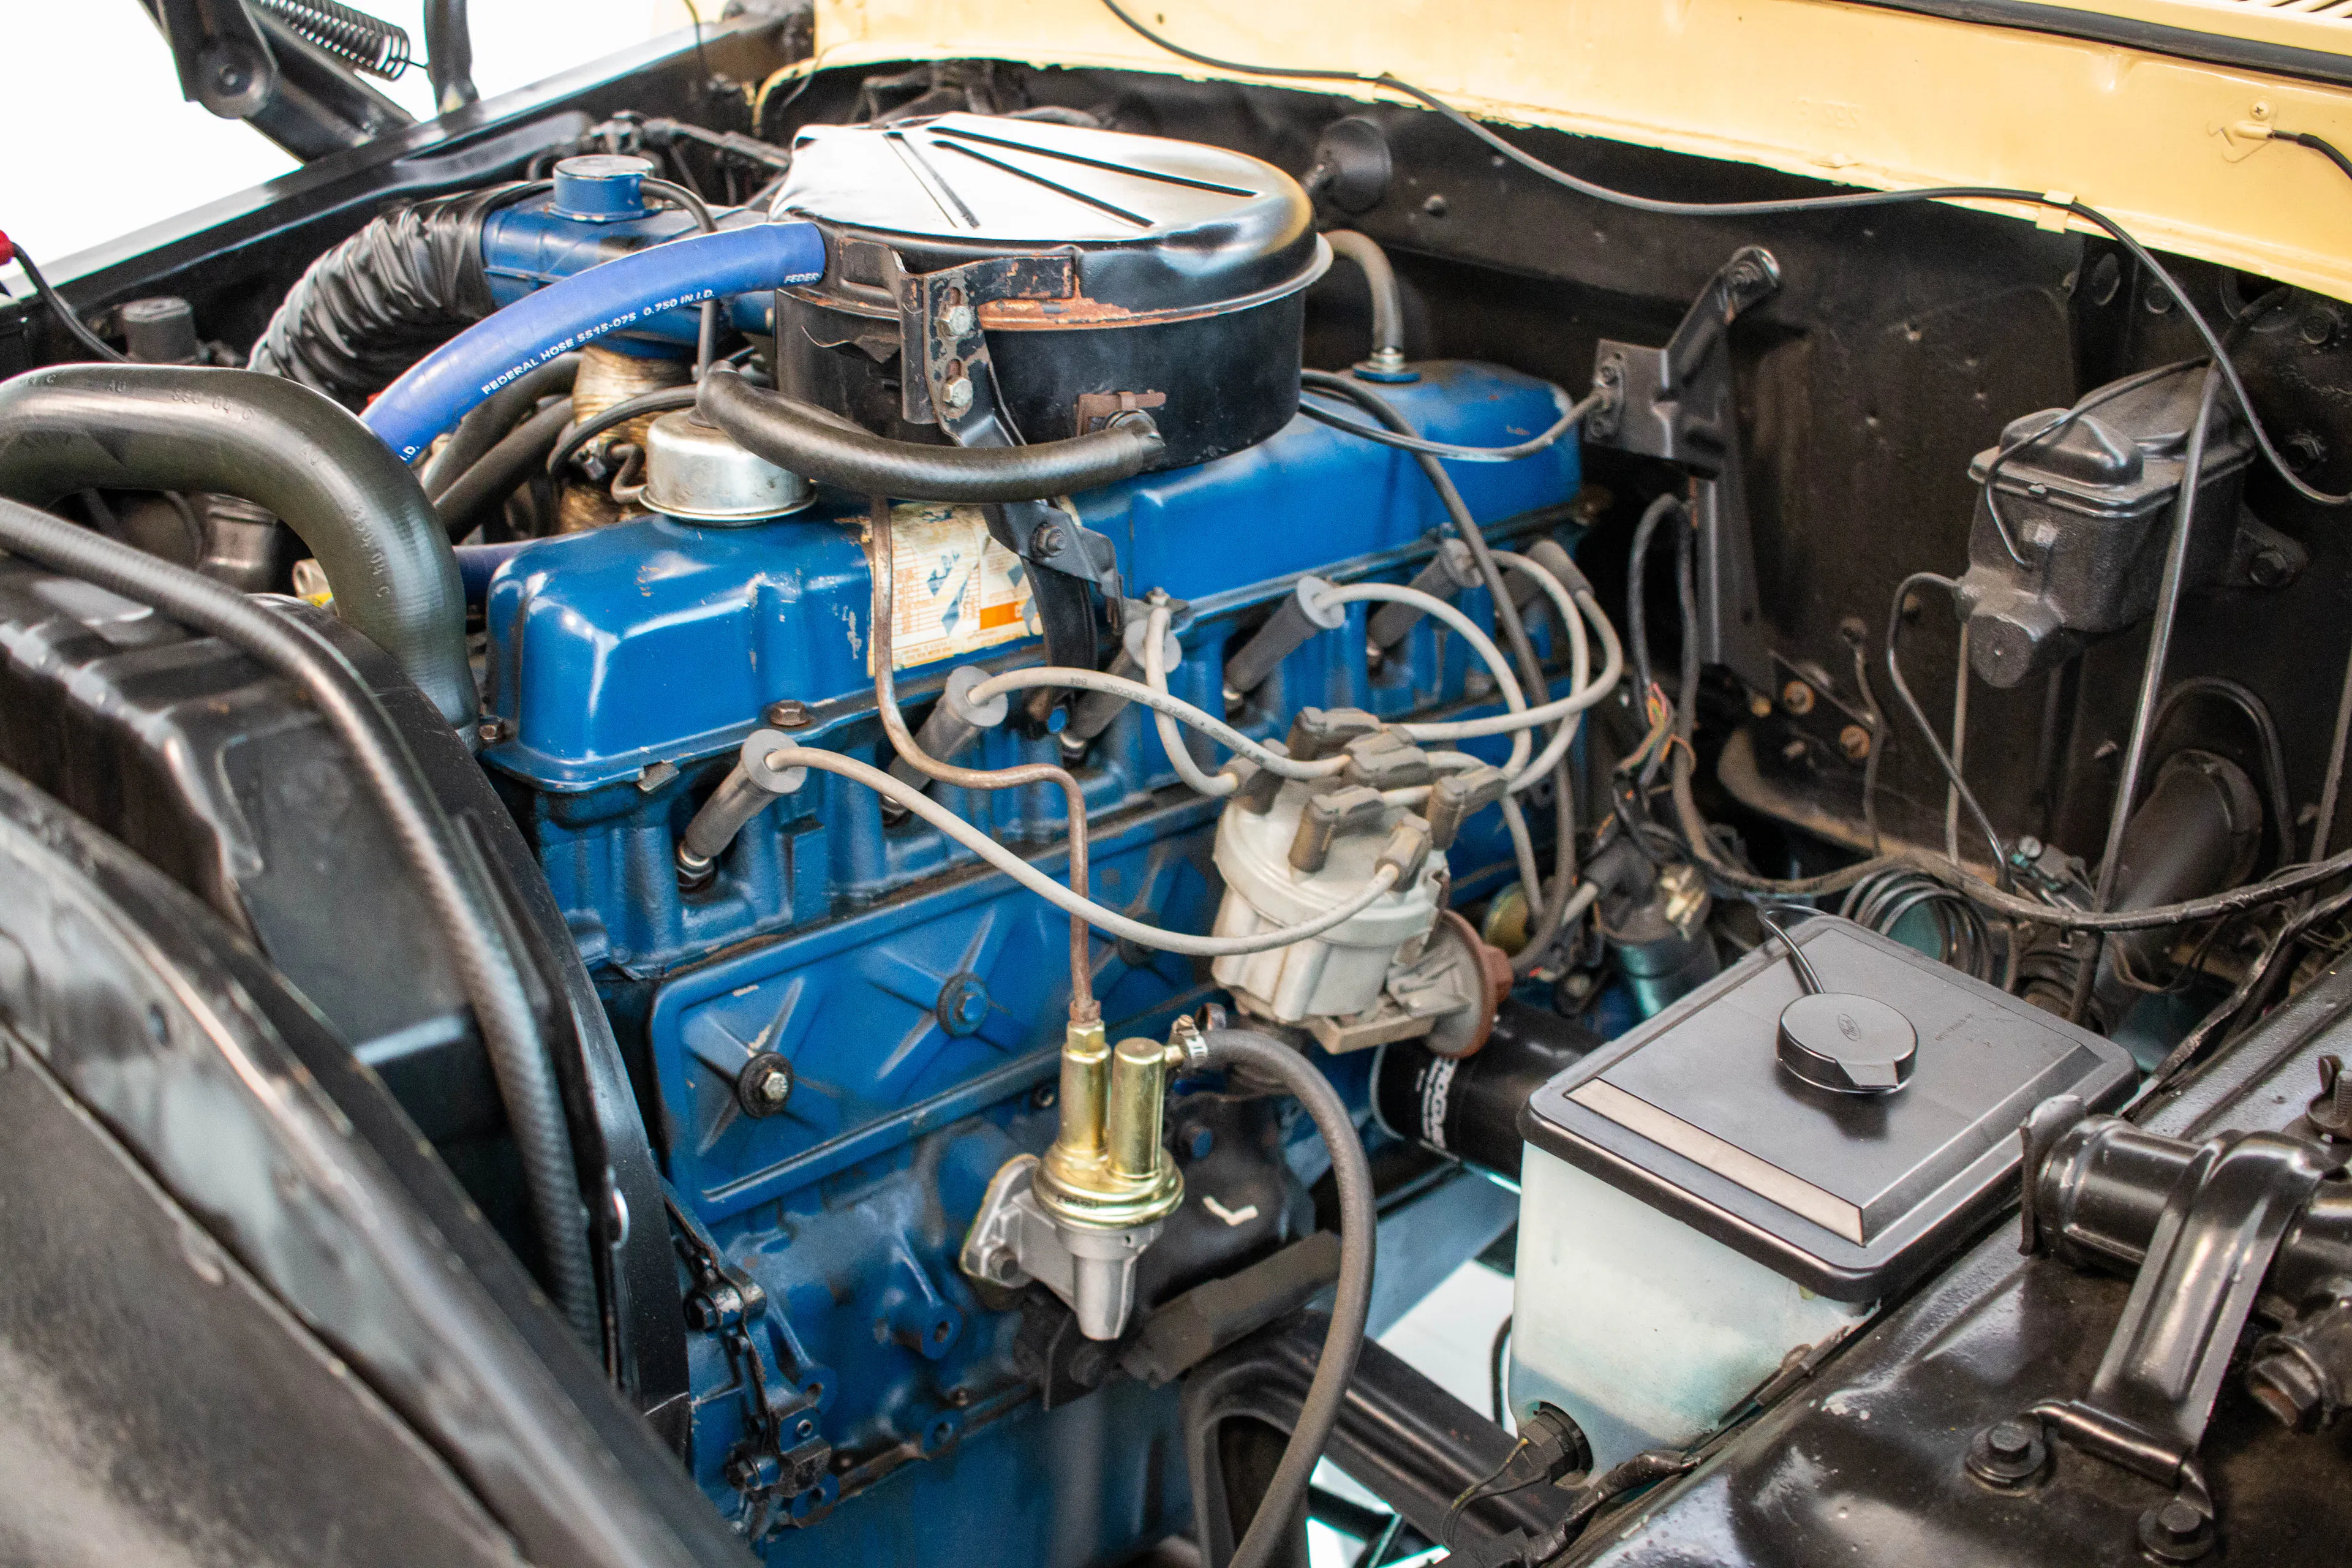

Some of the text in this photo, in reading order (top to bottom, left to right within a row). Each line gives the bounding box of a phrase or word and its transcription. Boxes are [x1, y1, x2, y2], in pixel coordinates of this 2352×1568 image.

[784, 272, 819, 284] FEDER
[481, 358, 540, 394] FEDERAL
[540, 338, 575, 361] HOSE
[576, 312, 637, 343] 5515-075
[643, 298, 677, 317] 0.750
[1103, 683, 1148, 703] SILICONE
